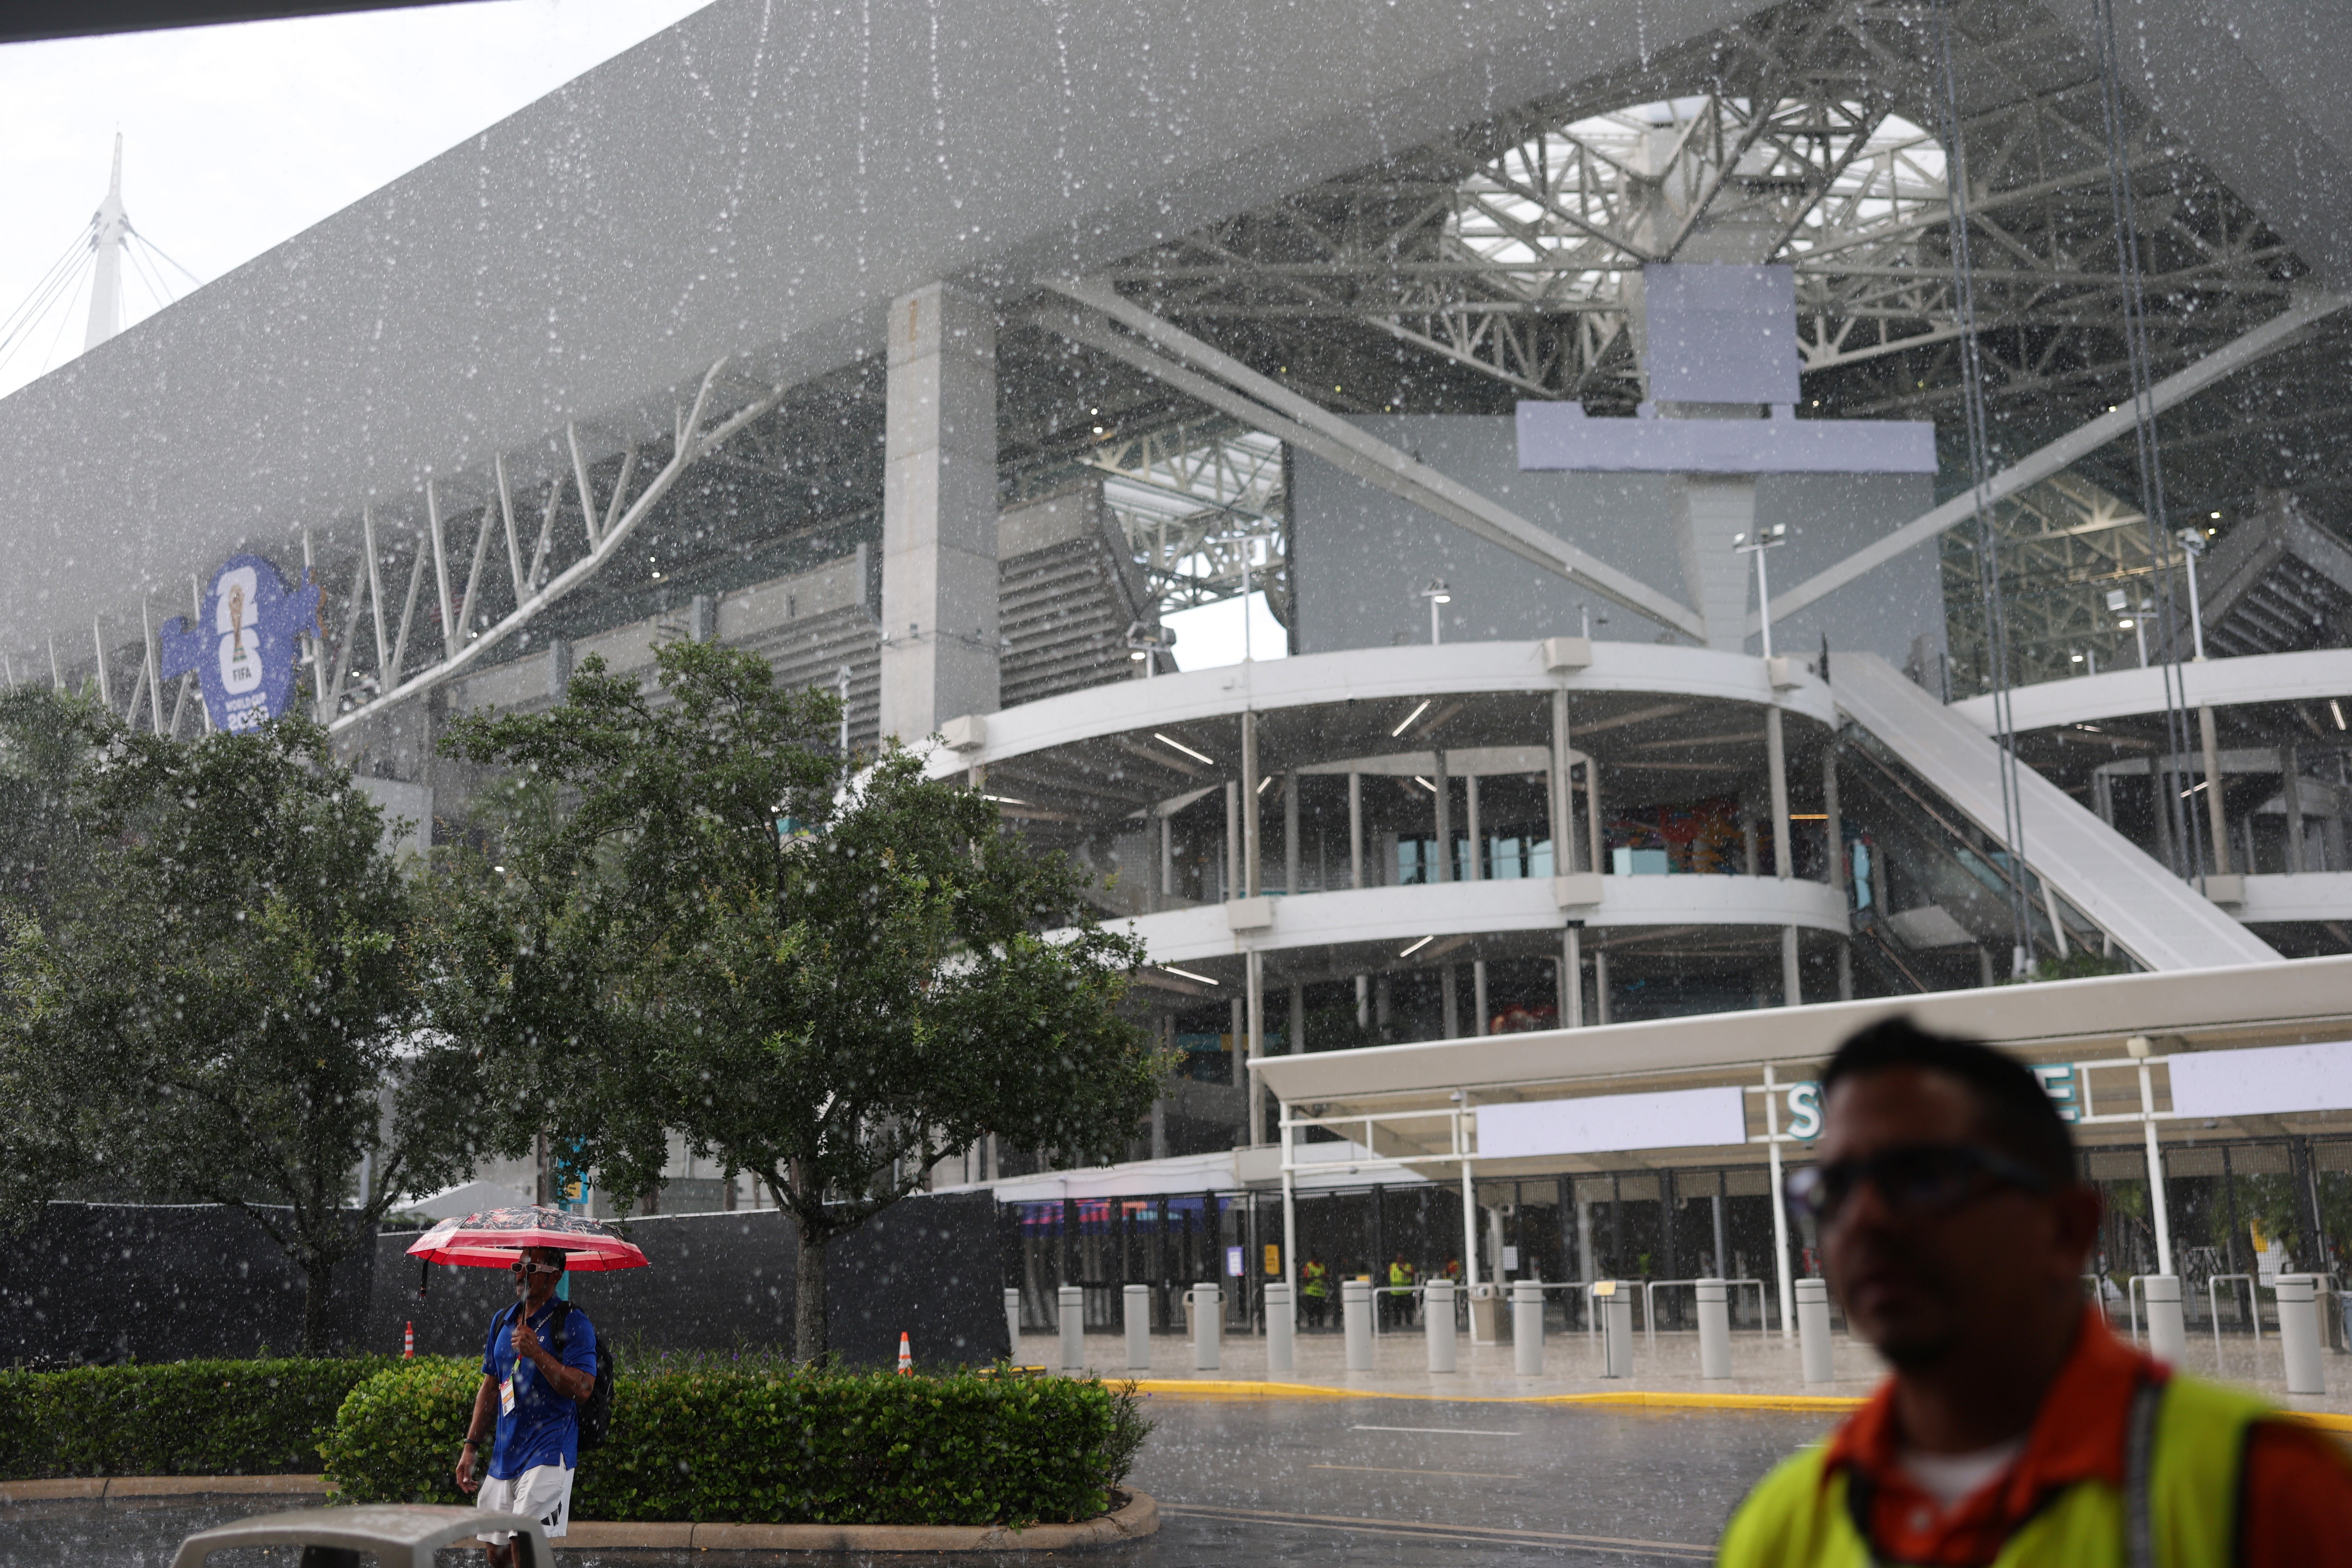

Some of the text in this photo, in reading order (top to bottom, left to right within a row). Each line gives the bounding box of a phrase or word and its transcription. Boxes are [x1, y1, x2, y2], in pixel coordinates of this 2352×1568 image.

[233, 667, 251, 682] FIFA
[225, 691, 267, 712] WORLD CUP
[538, 1317, 548, 1328] WORLD
